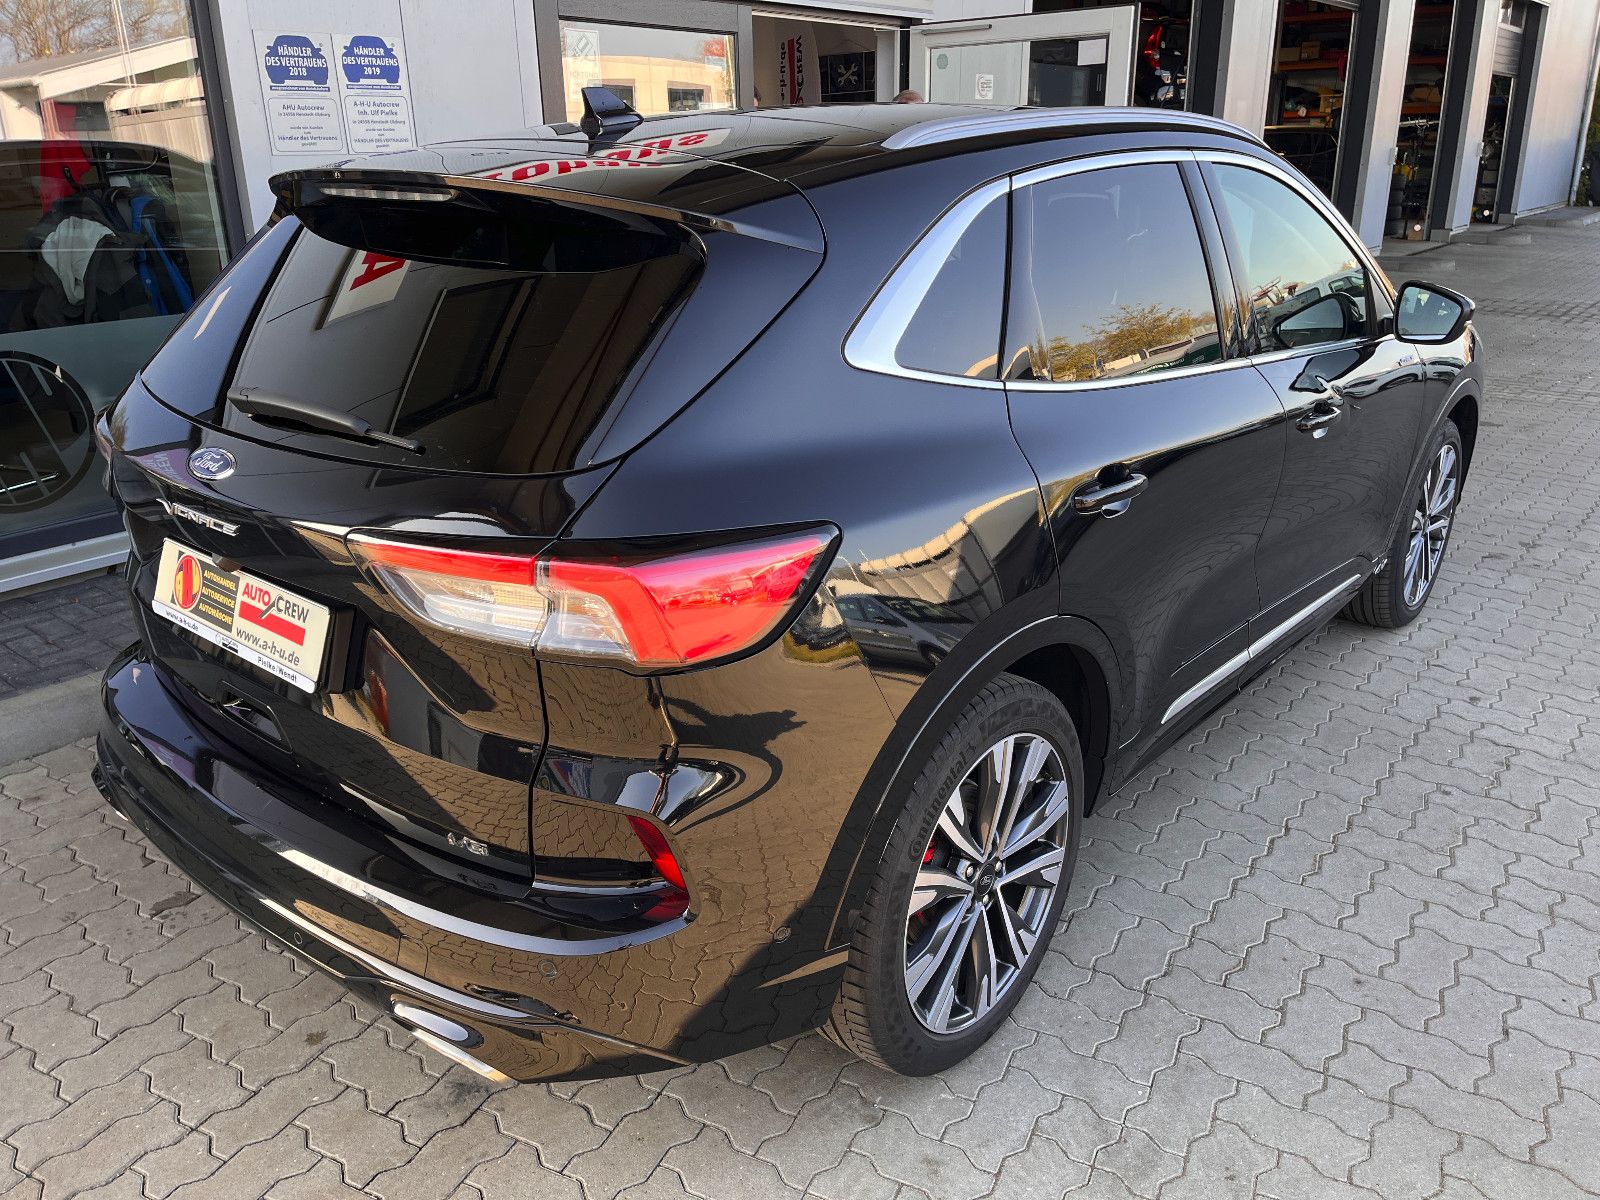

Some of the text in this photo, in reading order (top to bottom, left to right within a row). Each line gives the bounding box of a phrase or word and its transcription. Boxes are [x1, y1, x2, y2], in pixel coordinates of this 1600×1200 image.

[278, 45, 312, 56] HÄNDLER
[353, 46, 385, 56] HÄNDLER
[266, 57, 327, 67] DES VERTRAUENS
[343, 57, 398, 66] DES VERTRAUENS
[289, 67, 307, 76] 2018
[363, 67, 381, 75] 2019
[194, 451, 223, 473] Ford
[204, 569, 236, 592] AUTOHANDEL
[202, 586, 235, 609] AUTOSERVICE
[241, 582, 309, 623] AUTO CREW
[237, 627, 300, 667] www.a-h-u.de
